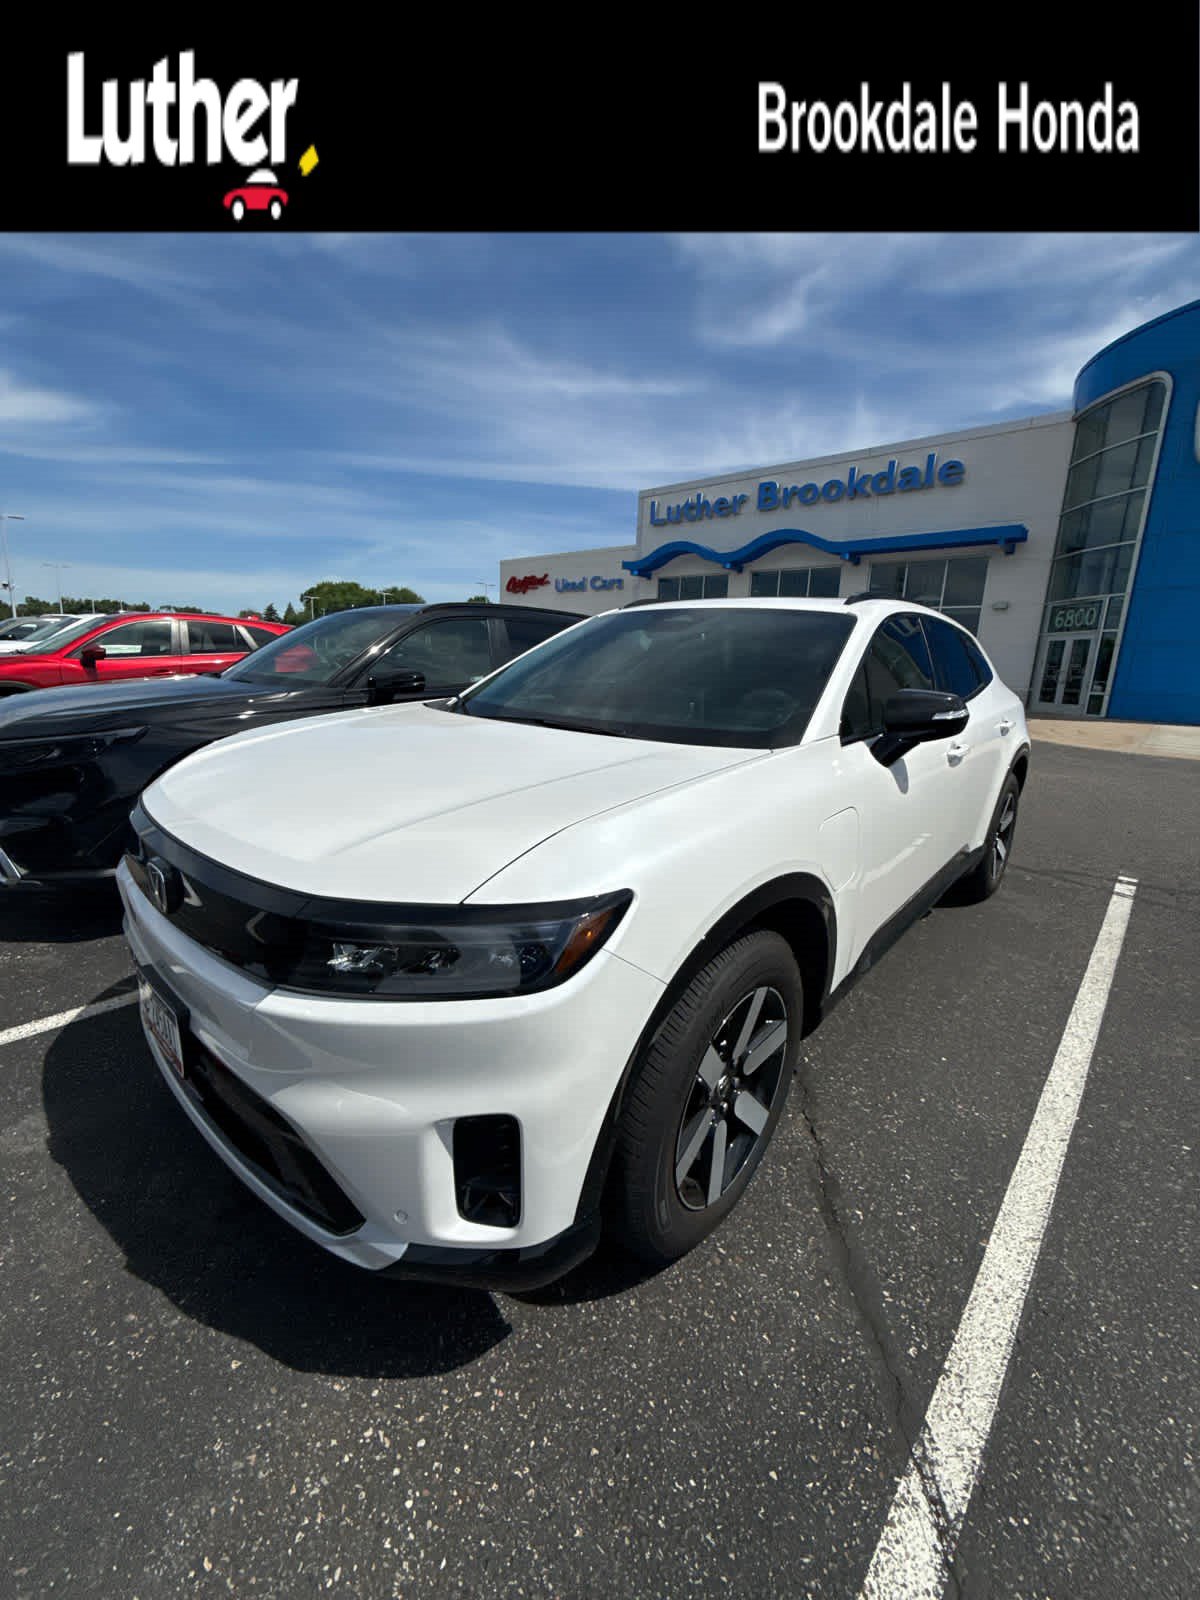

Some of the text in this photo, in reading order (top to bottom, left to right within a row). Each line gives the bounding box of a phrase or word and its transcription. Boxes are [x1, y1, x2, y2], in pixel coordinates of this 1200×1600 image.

[649, 452, 966, 526] Luther Brookdale
[555, 577, 588, 592] Used
[590, 575, 624, 591] Cars
[1055, 607, 1097, 628] 6800
